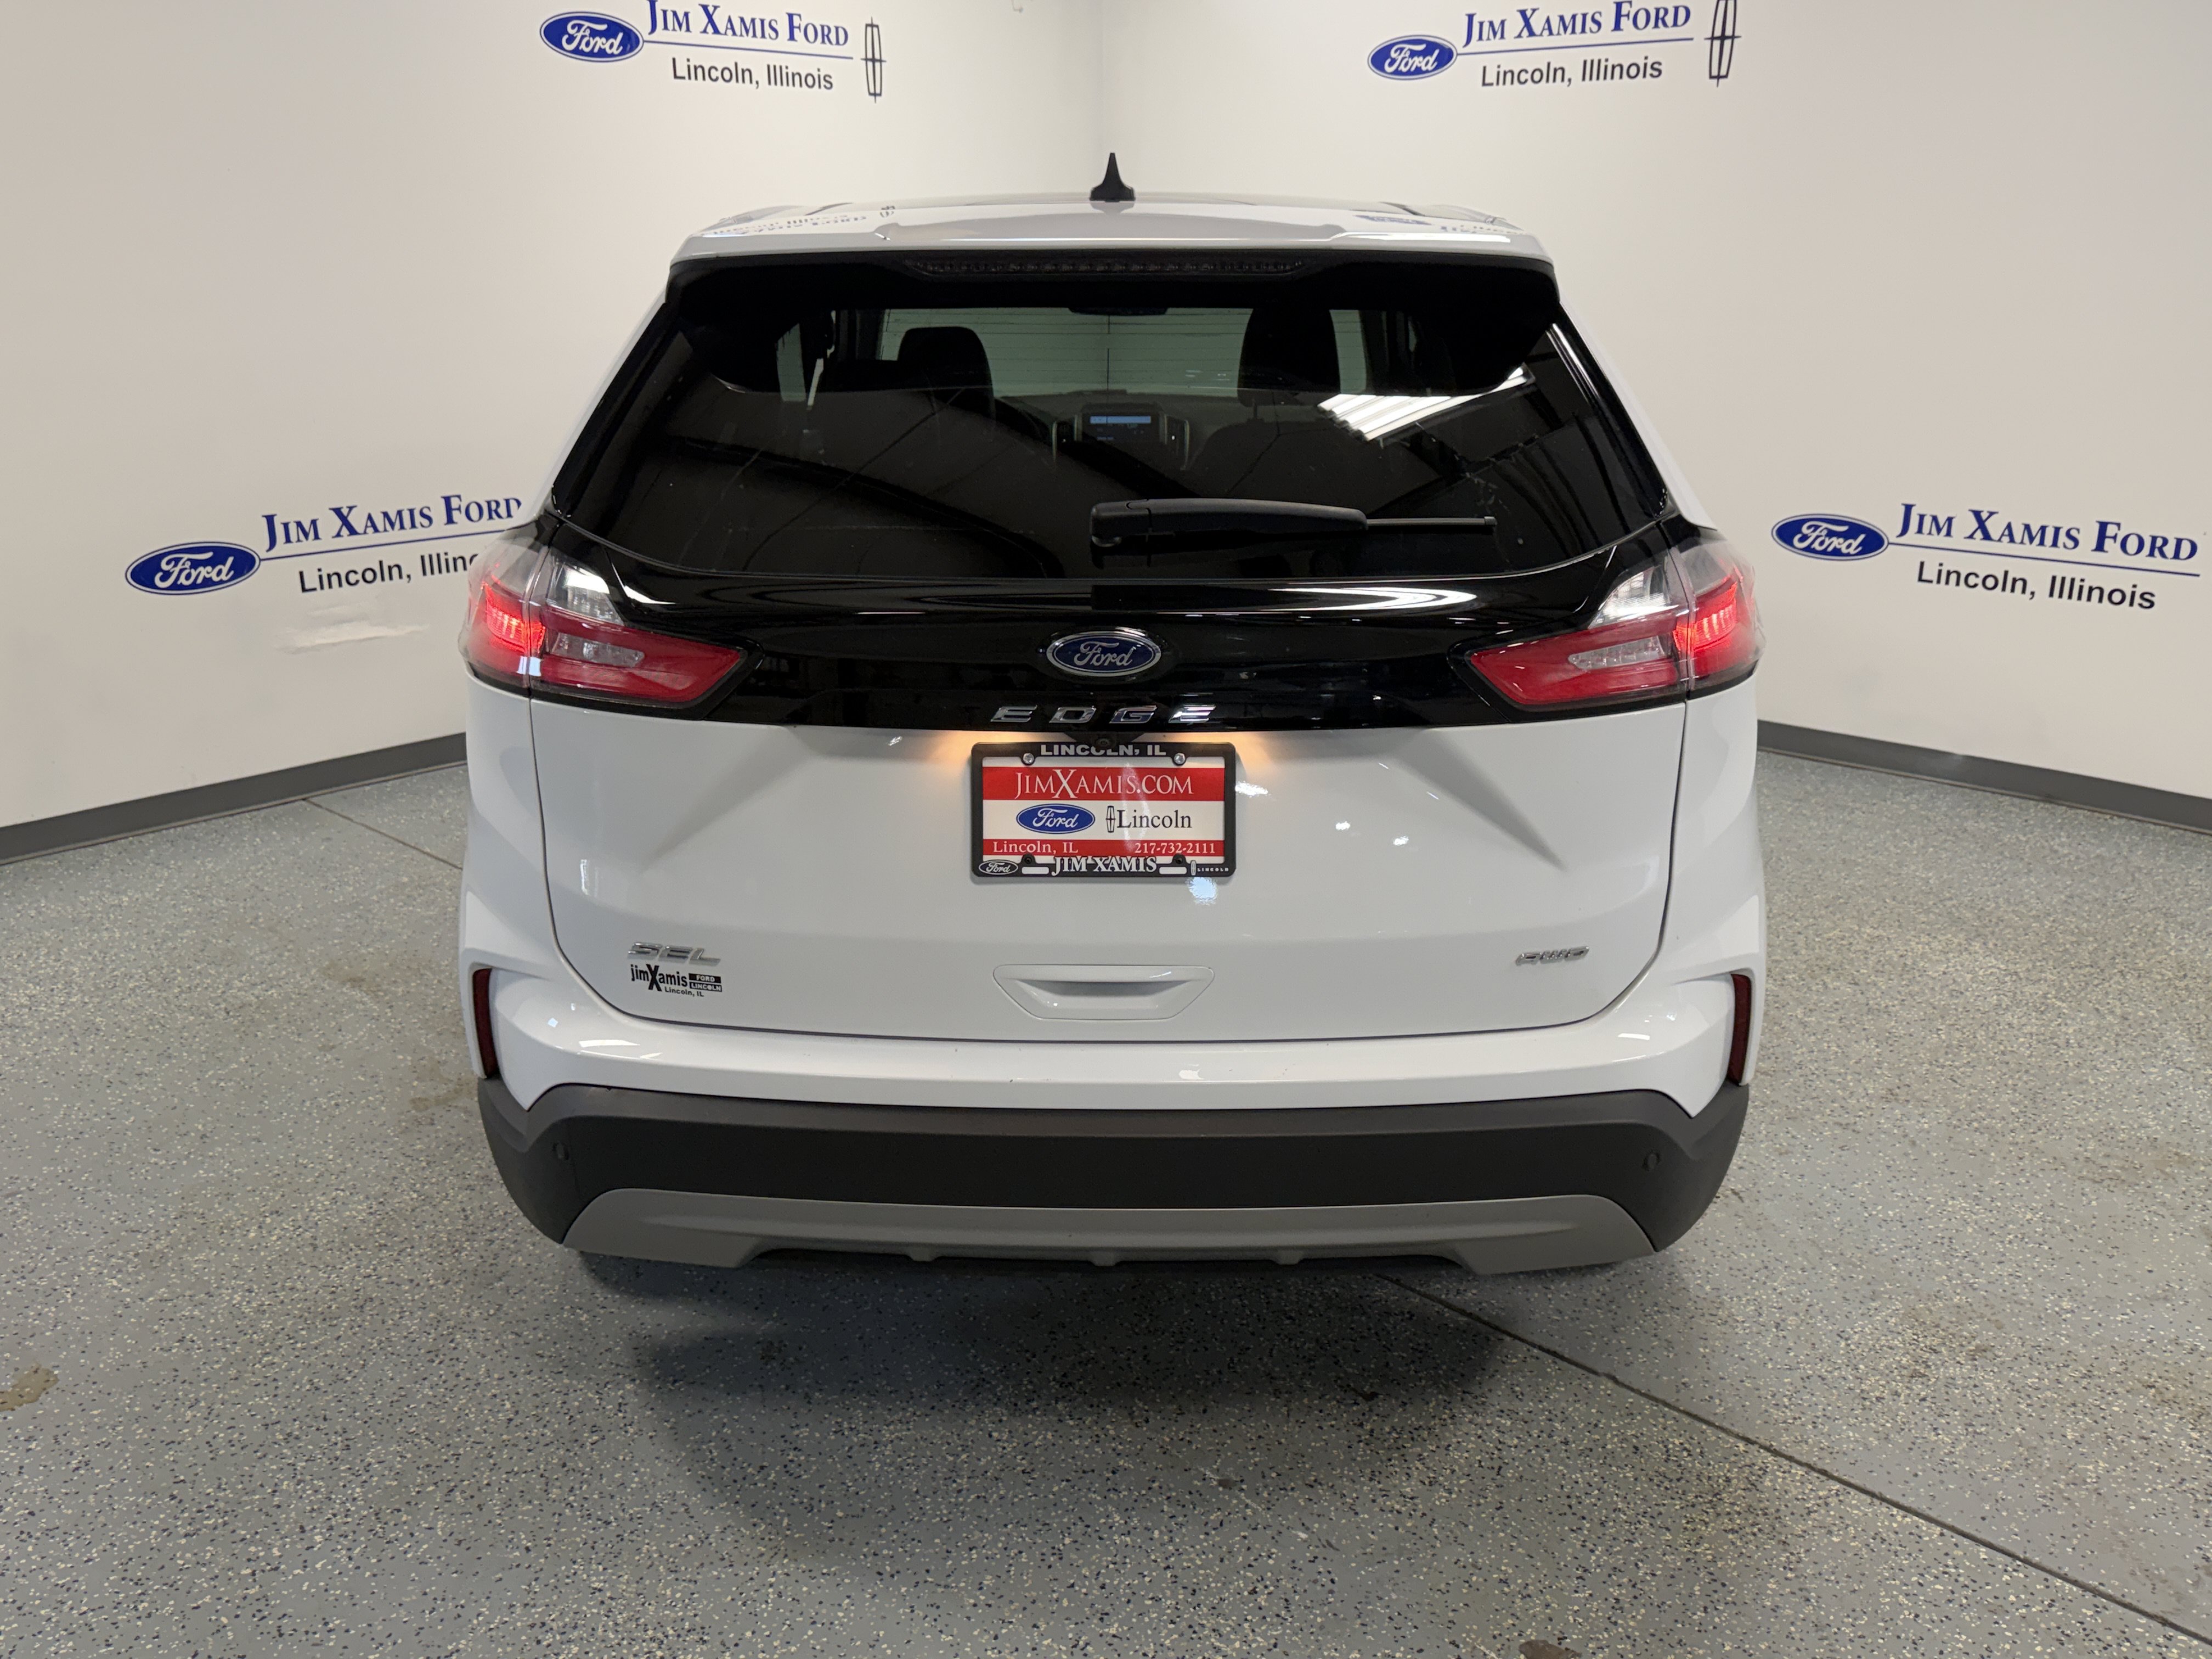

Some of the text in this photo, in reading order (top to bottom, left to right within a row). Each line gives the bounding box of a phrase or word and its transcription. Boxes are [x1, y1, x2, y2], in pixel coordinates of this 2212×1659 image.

[562, 20, 623, 55] Ford
[647, 0, 849, 46] JIM XAMIS FORD
[1462, 1, 1691, 48] JIM XAMIS FORD
[1384, 43, 1440, 72] Ford
[1481, 57, 1663, 87] Lincoln, Illinois
[672, 58, 834, 89] Lincoln, Illinois
[262, 514, 321, 552] JIM
[329, 505, 433, 539] XAMIS
[1793, 520, 1865, 555] Ford
[1896, 503, 2198, 561] JIM XAMIS FORD
[154, 551, 234, 588] Ford
[298, 552, 478, 593] Lincoln, Illin
[1917, 561, 2157, 610] Lincoln, Illinois
[1074, 640, 1133, 667] Ford
[990, 704, 1217, 724] EDGE
[1147, 744, 1166, 755] IL
[1014, 769, 1194, 799] JIMXAMIS.COM
[1032, 808, 1192, 829] Ford Lincoln
[993, 841, 1215, 855] Lincoln, IL 217-732-2111
[986, 862, 1010, 873] Ford
[1051, 856, 1157, 876] JIM XAMIS
[628, 942, 721, 967] SEL
[1515, 946, 1589, 966] AWD
[664, 986, 695, 997] Lincoln,
[691, 983, 721, 991] LINCOLN
[696, 974, 715, 983] FORD
